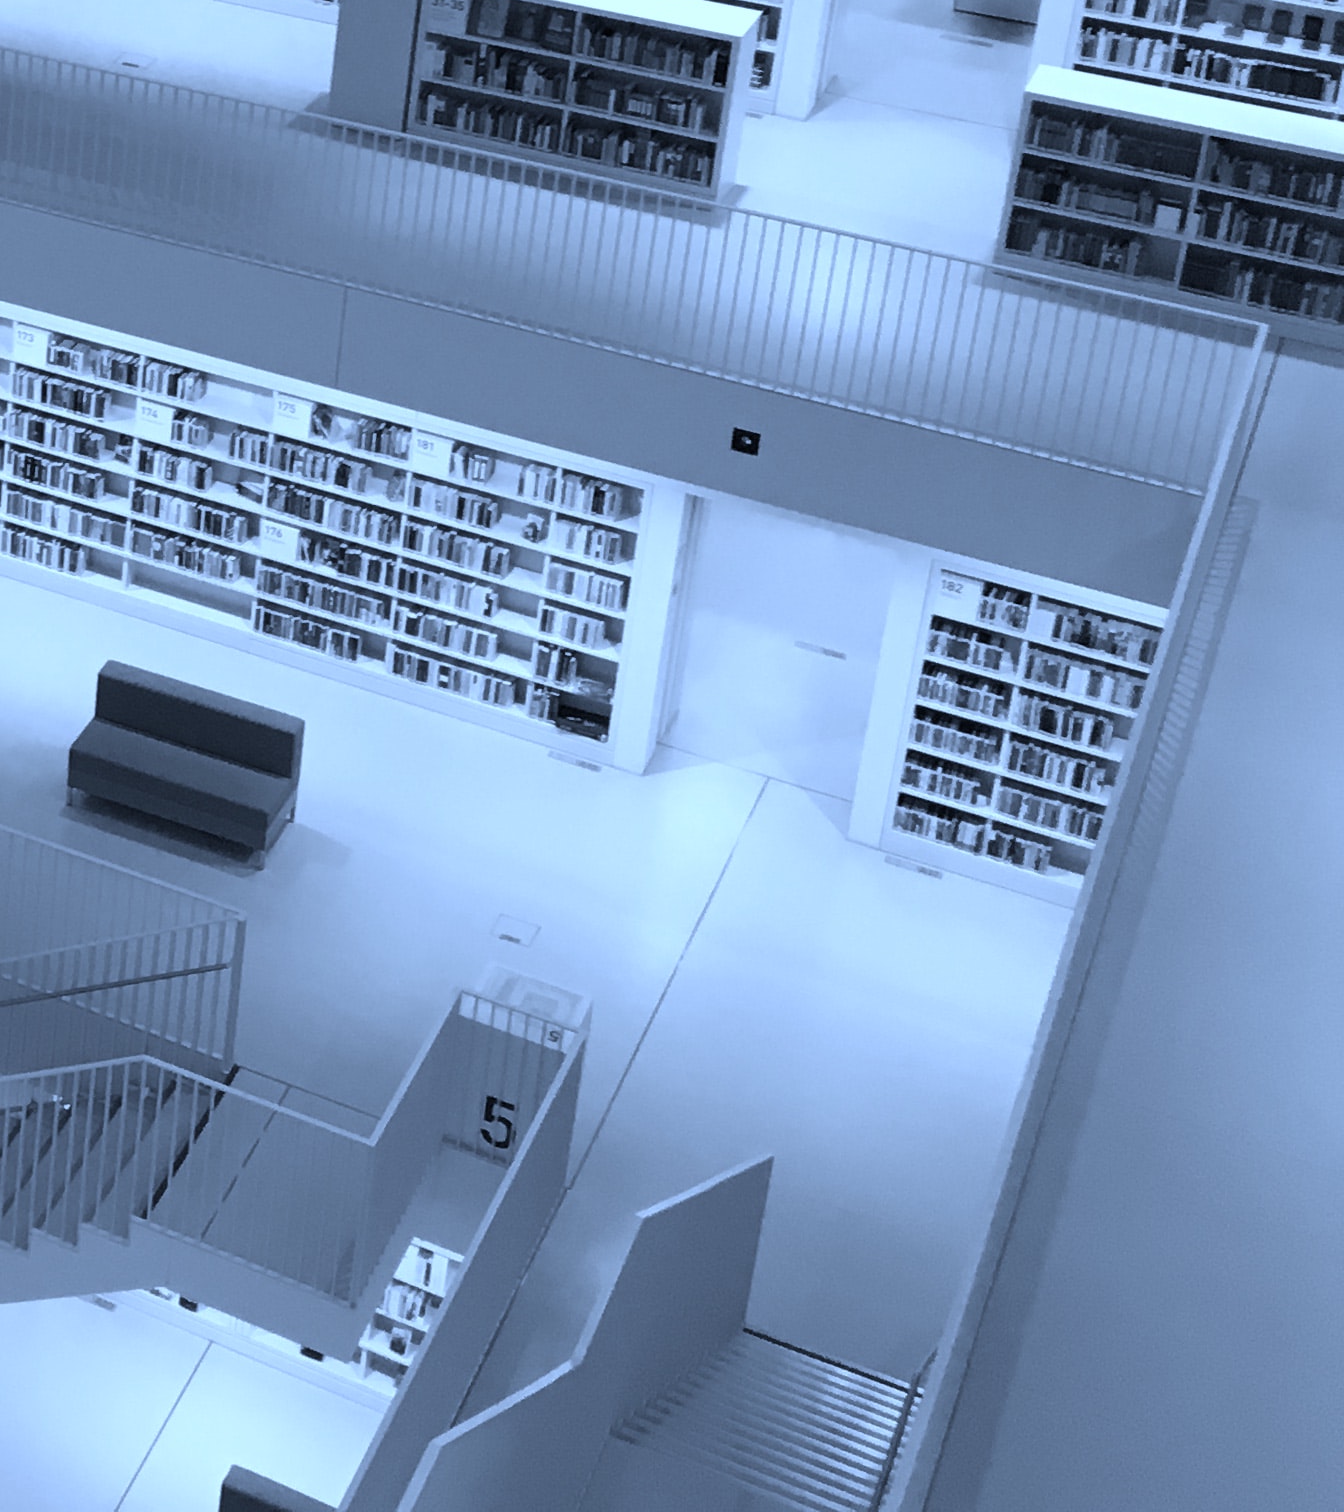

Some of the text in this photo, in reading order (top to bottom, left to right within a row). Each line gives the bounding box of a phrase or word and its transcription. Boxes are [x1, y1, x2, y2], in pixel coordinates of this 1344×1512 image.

[17, 330, 35, 343] 173
[141, 406, 159, 419] 174
[277, 400, 296, 414] 175
[417, 439, 434, 451] 181
[264, 525, 283, 538] 176
[941, 579, 964, 594] 182
[480, 1095, 517, 1149] 5
